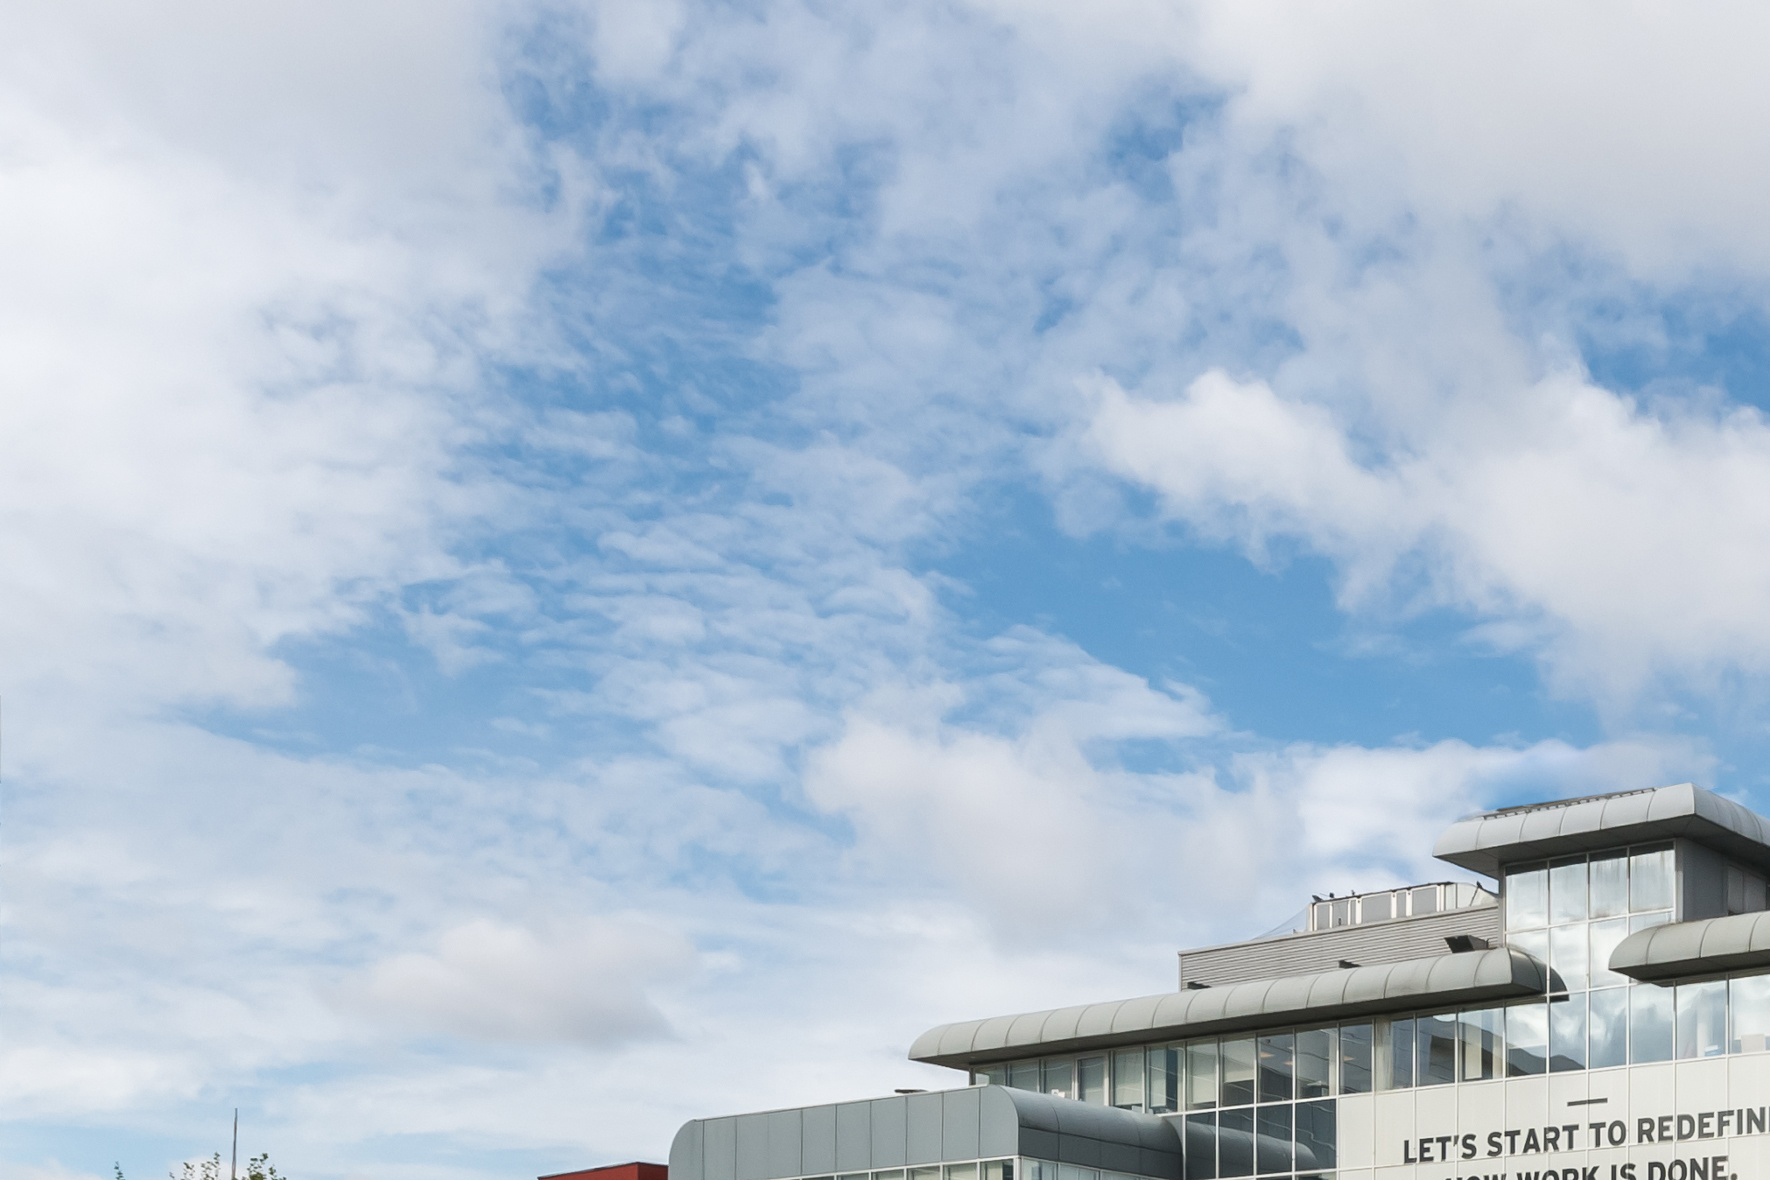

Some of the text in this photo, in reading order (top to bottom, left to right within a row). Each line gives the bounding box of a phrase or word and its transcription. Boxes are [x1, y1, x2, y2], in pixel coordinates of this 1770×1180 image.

[1403, 1133, 1477, 1163] LET'S
[1486, 1124, 1579, 1157] START
[1588, 1119, 1627, 1148] TO
